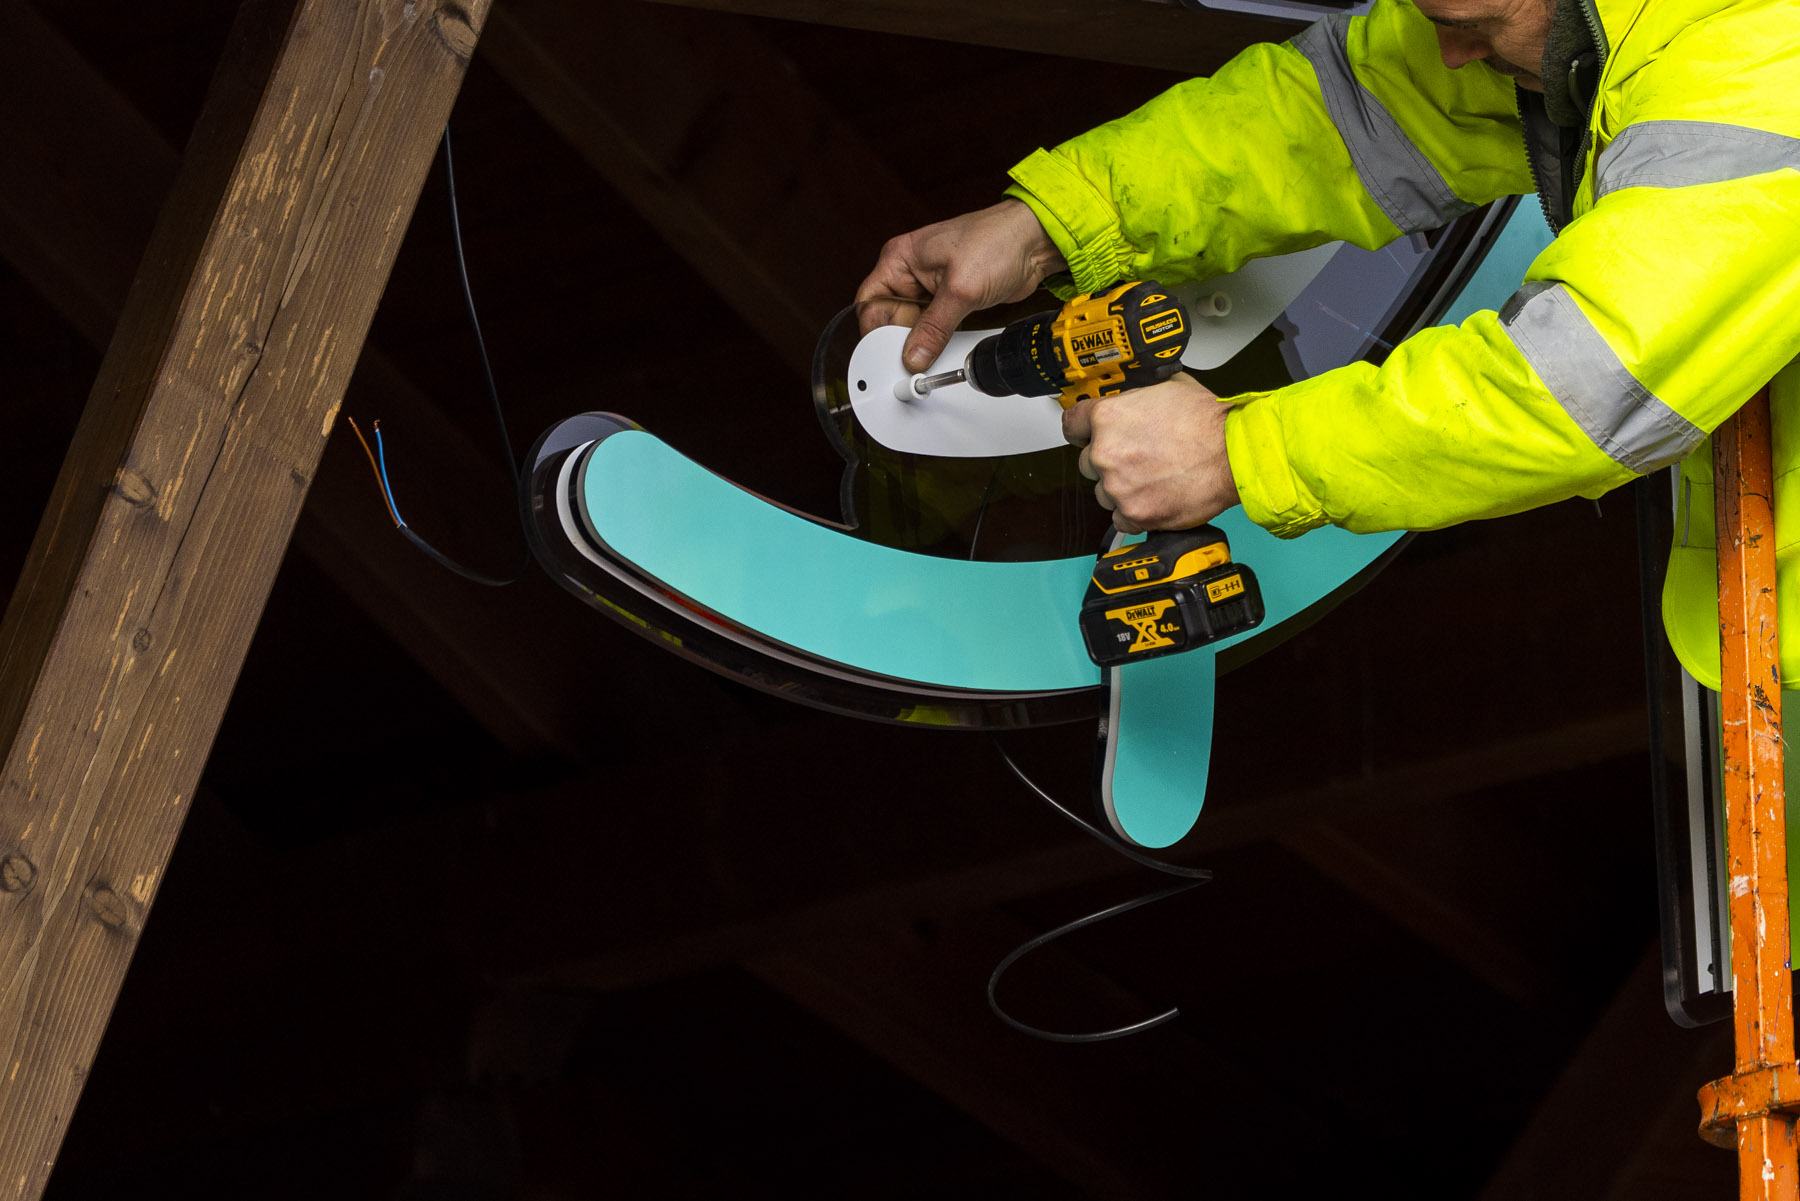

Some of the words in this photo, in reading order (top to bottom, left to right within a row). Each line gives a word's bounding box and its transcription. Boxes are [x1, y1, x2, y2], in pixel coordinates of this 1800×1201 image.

[1145, 316, 1178, 333] BRUSHLESS
[1152, 323, 1174, 335] MOTOR
[1116, 631, 1131, 643] 18V
